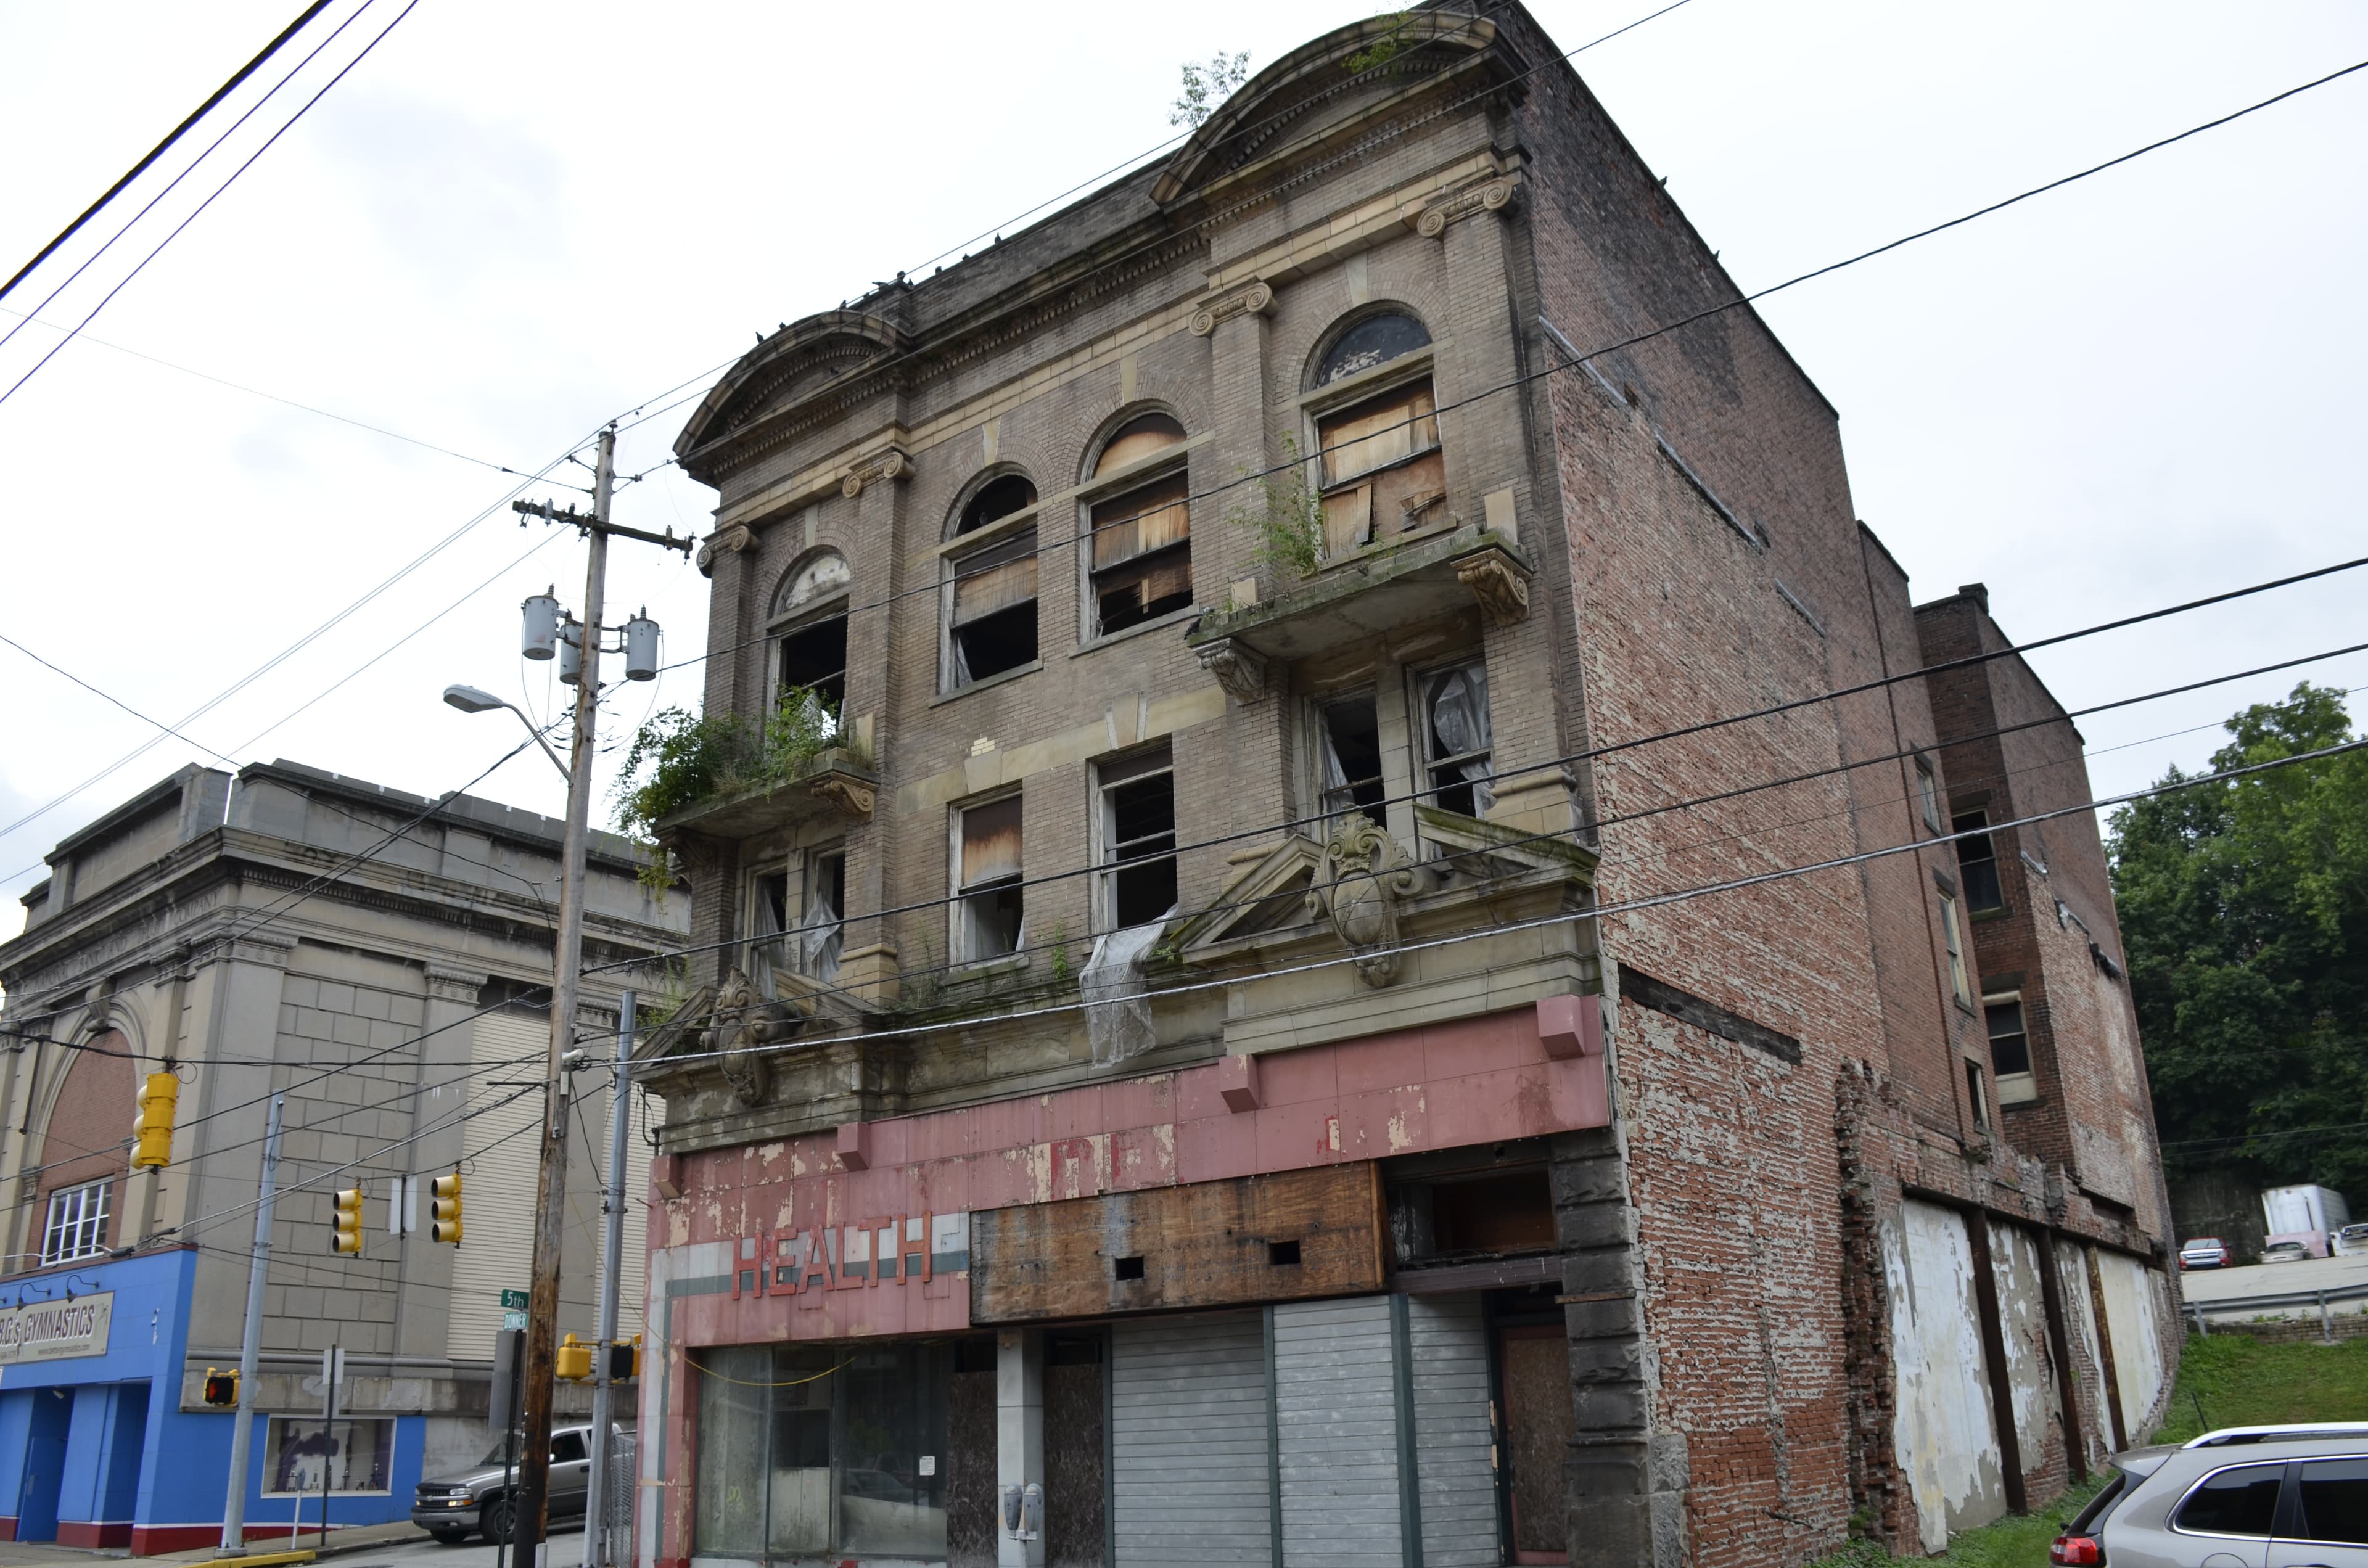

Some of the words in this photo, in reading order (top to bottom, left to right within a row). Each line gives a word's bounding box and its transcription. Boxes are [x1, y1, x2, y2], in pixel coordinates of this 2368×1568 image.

[173, 887, 220, 925] COMPANY
[732, 1211, 932, 1300] HEALTH
[507, 1291, 524, 1307] 5th
[24, 1304, 94, 1343] GYMNASTICS
[504, 1313, 527, 1329] DONNER
